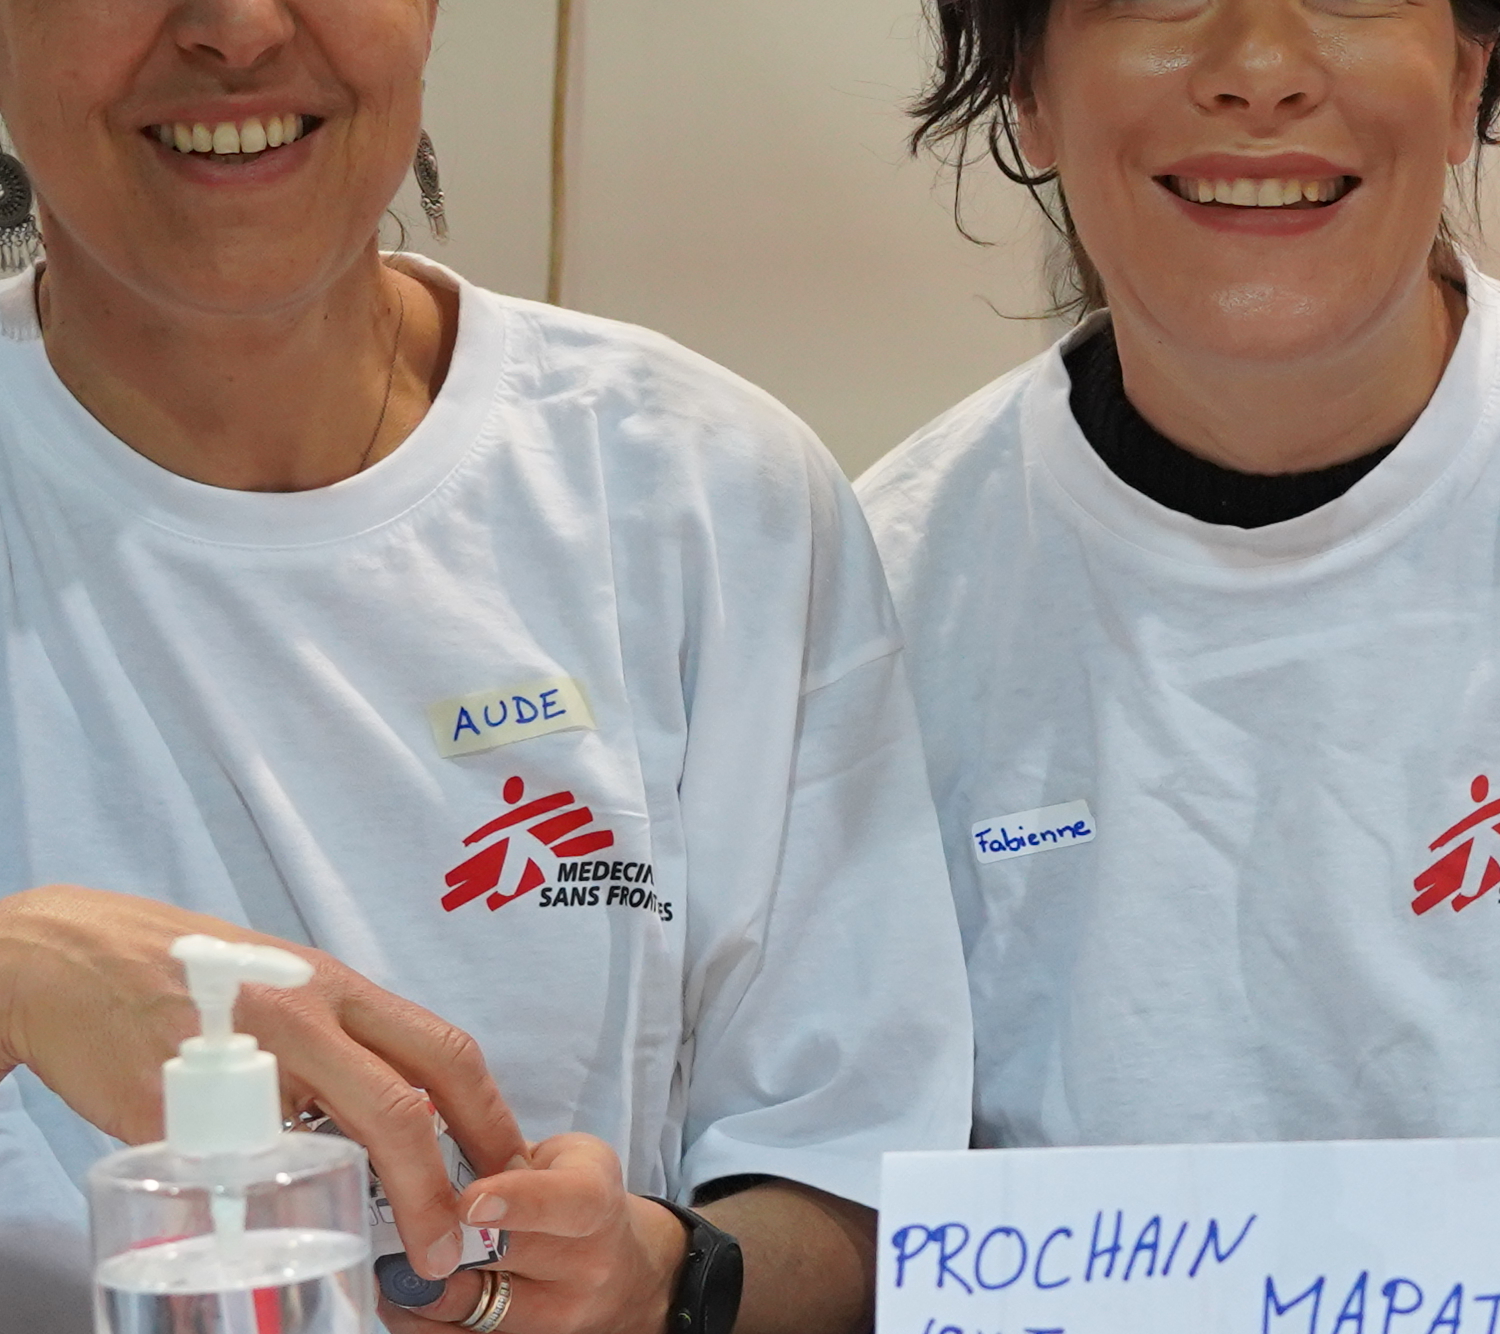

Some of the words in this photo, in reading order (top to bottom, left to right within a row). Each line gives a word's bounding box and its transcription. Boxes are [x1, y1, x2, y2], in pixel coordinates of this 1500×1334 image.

[453, 688, 567, 742] AUDE
[974, 819, 1092, 854] Fabienne
[557, 860, 655, 887] MEDECIN
[539, 886, 600, 908] SANS
[892, 1209, 1258, 1297] PROCHAIN
